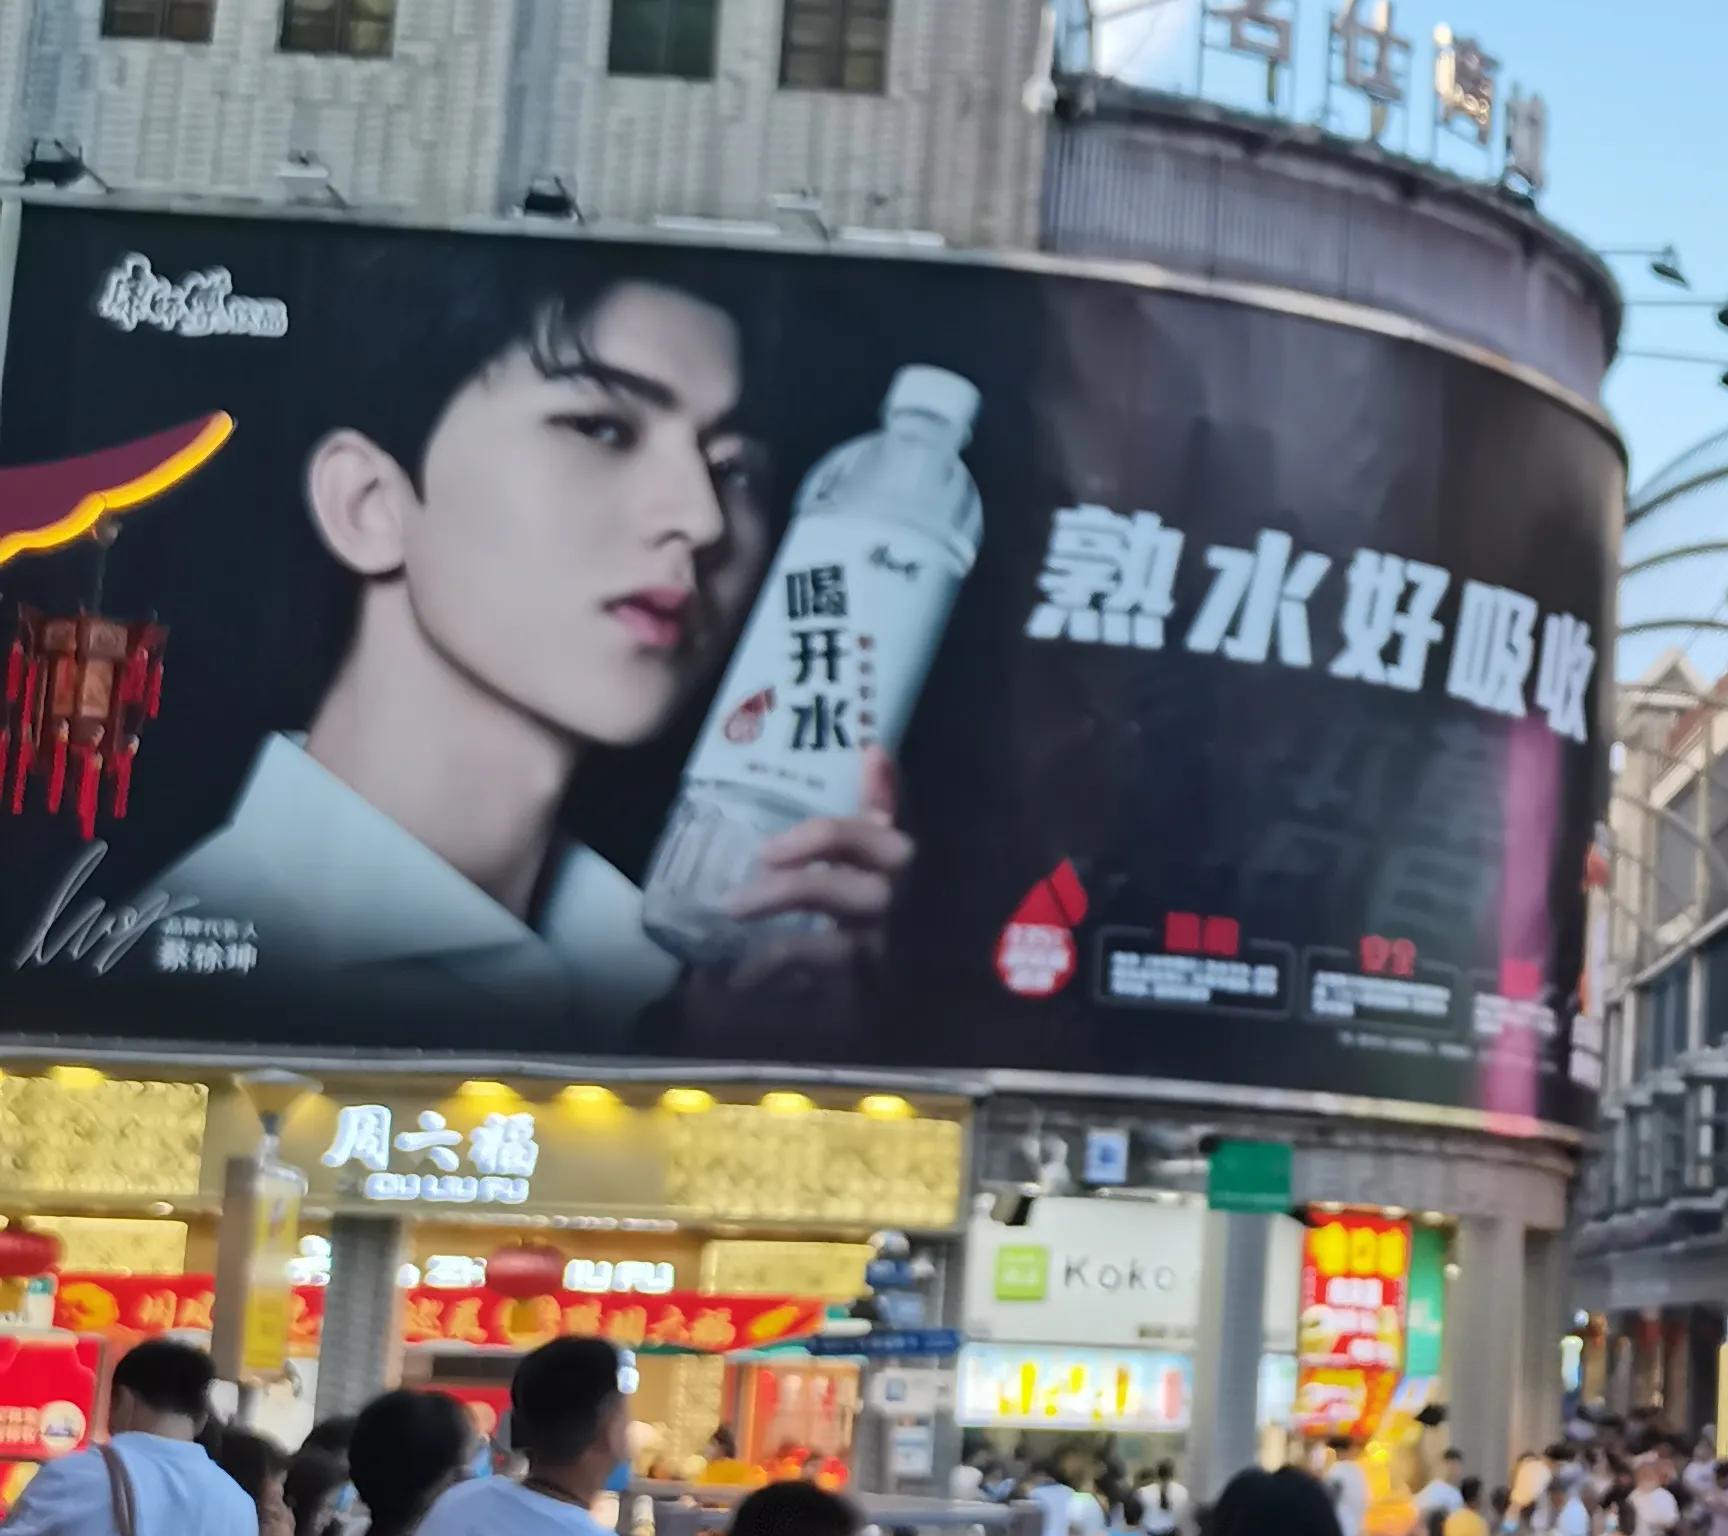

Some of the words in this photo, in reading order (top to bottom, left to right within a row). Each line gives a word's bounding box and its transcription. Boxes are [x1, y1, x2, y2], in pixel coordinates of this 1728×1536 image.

[786, 564, 852, 752] 喝开水
[1025, 502, 1596, 744] 熟水好吸收
[322, 1104, 539, 1177] 周六福
